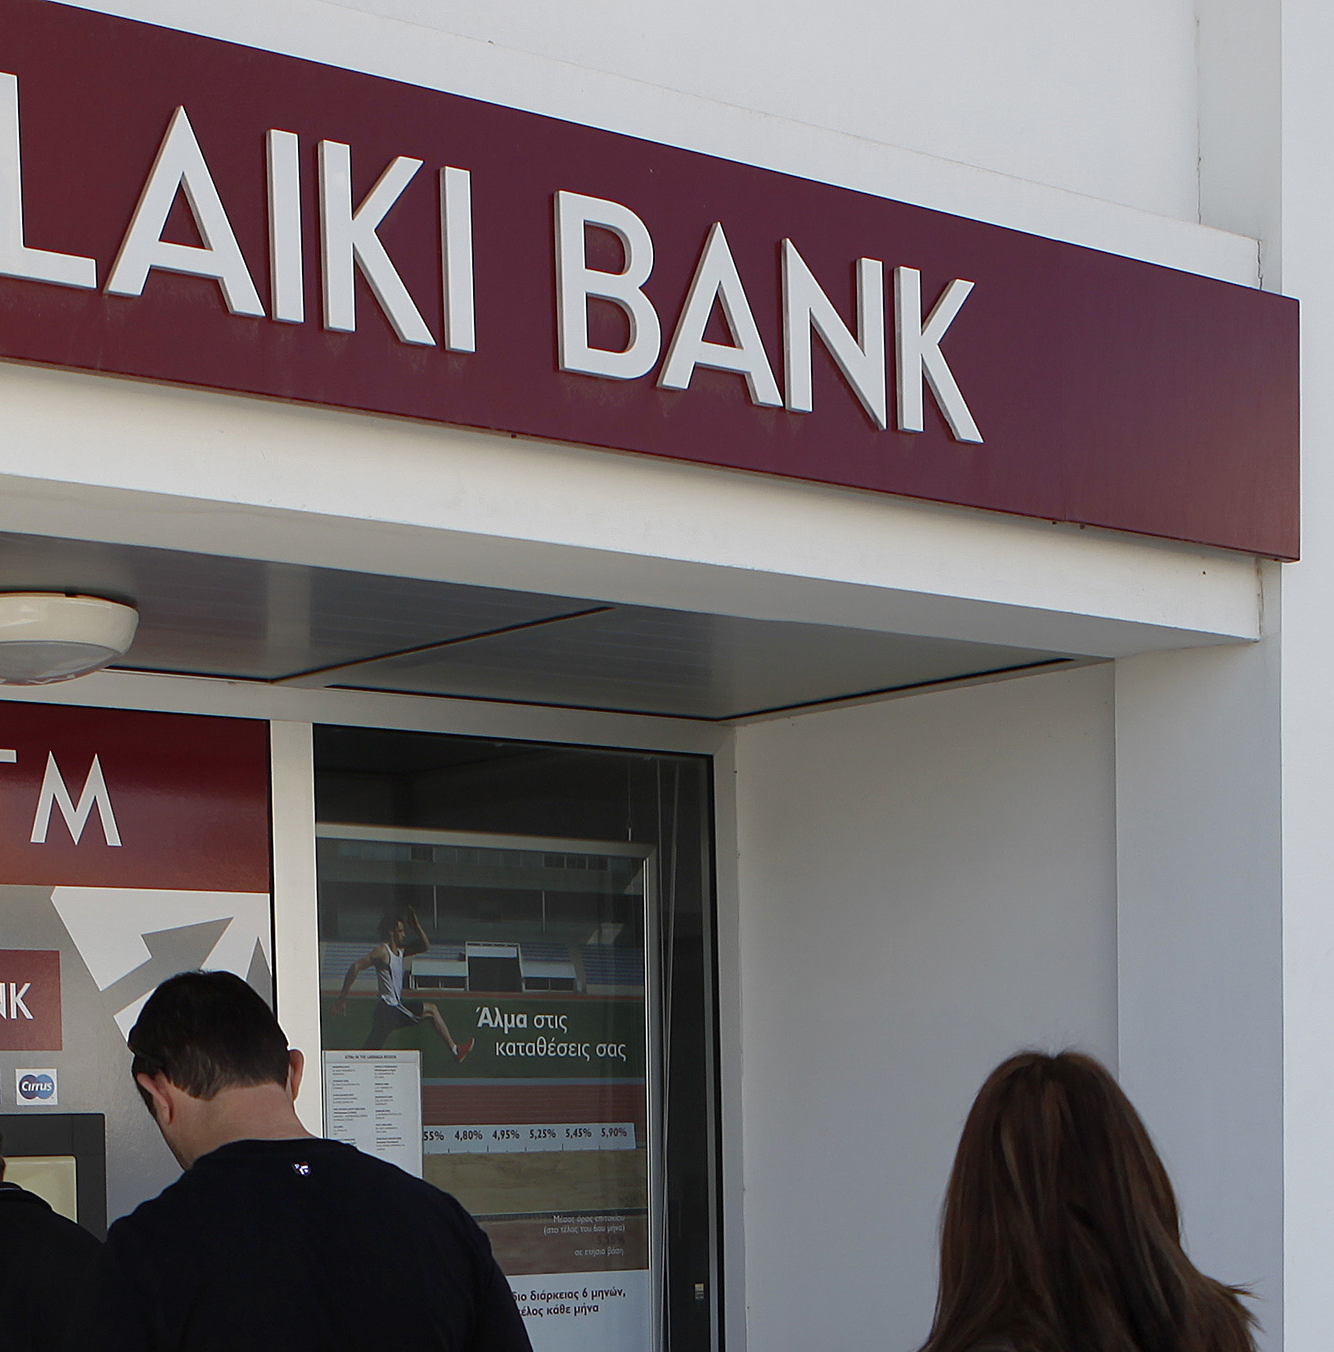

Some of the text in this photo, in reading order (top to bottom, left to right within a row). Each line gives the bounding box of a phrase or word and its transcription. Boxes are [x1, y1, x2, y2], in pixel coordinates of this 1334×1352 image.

[553, 188, 985, 445] BANK
[476, 1006, 568, 1034] Άλμα στις
[496, 1036, 627, 1062] καταθέσεις σας
[21, 1081, 53, 1093] Cirrus
[454, 1129, 483, 1142] 4,80%
[492, 1128, 520, 1141] 4,95%
[529, 1127, 557, 1140] 5,25%
[565, 1126, 592, 1139] 5,45%
[601, 1126, 628, 1138] 5,90%
[530, 1289, 579, 1303] διάρκειας
[582, 1287, 588, 1298] 6
[591, 1286, 626, 1300] μηνών,
[547, 1303, 571, 1316] κάθε
[574, 1302, 599, 1317] μήνα
